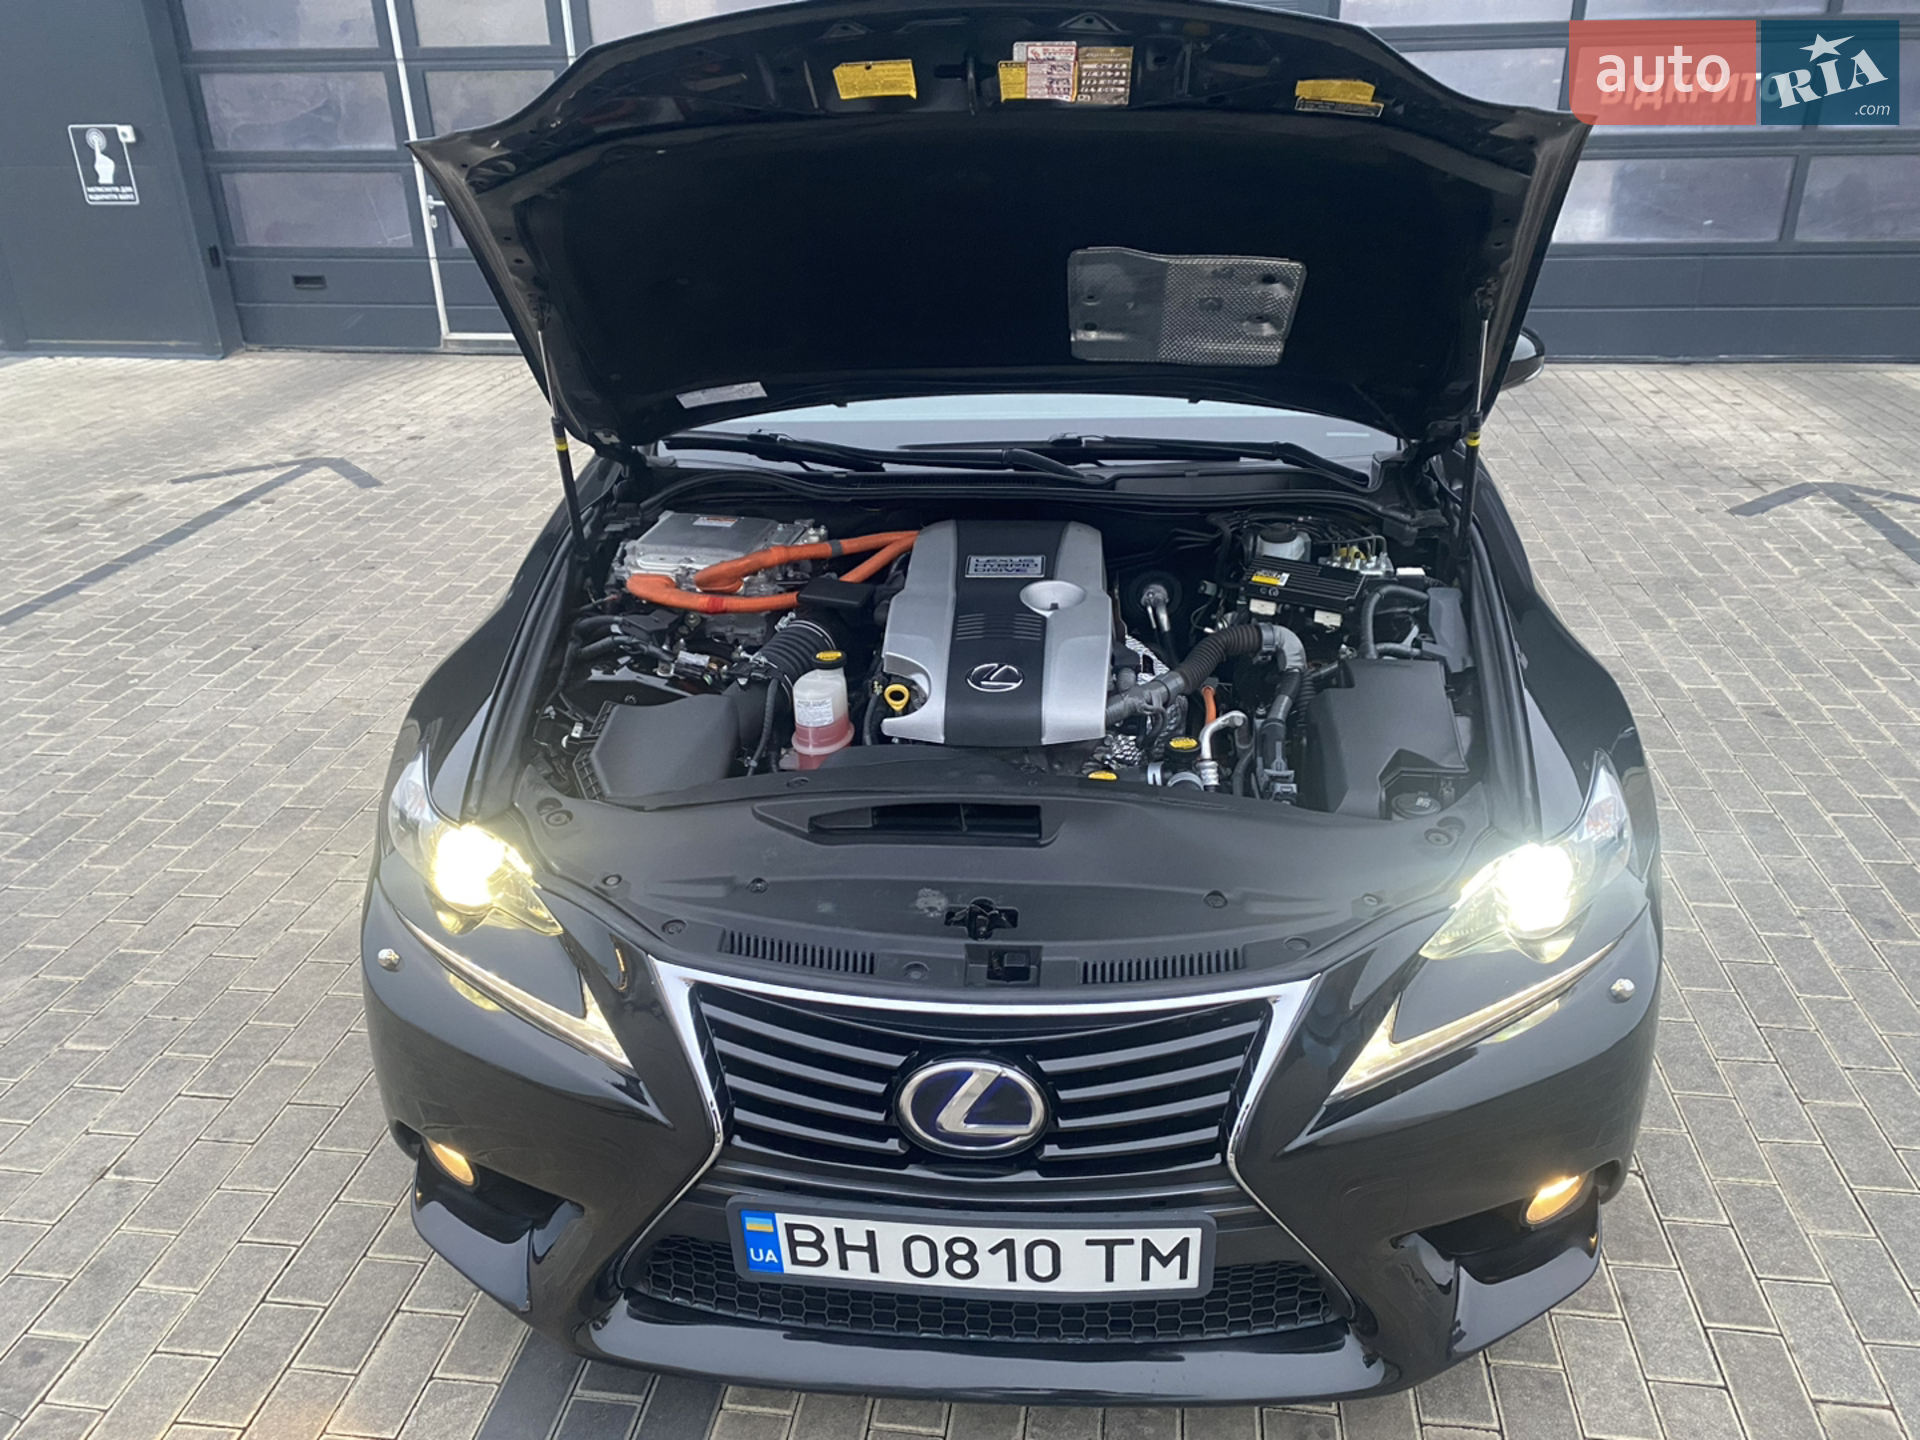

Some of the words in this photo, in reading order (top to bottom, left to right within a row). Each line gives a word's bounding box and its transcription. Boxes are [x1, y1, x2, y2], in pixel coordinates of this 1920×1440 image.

[749, 1247, 779, 1264] UA
[784, 1222, 880, 1274] BH
[902, 1234, 1062, 1284] 0810
[1085, 1236, 1190, 1283] TM
